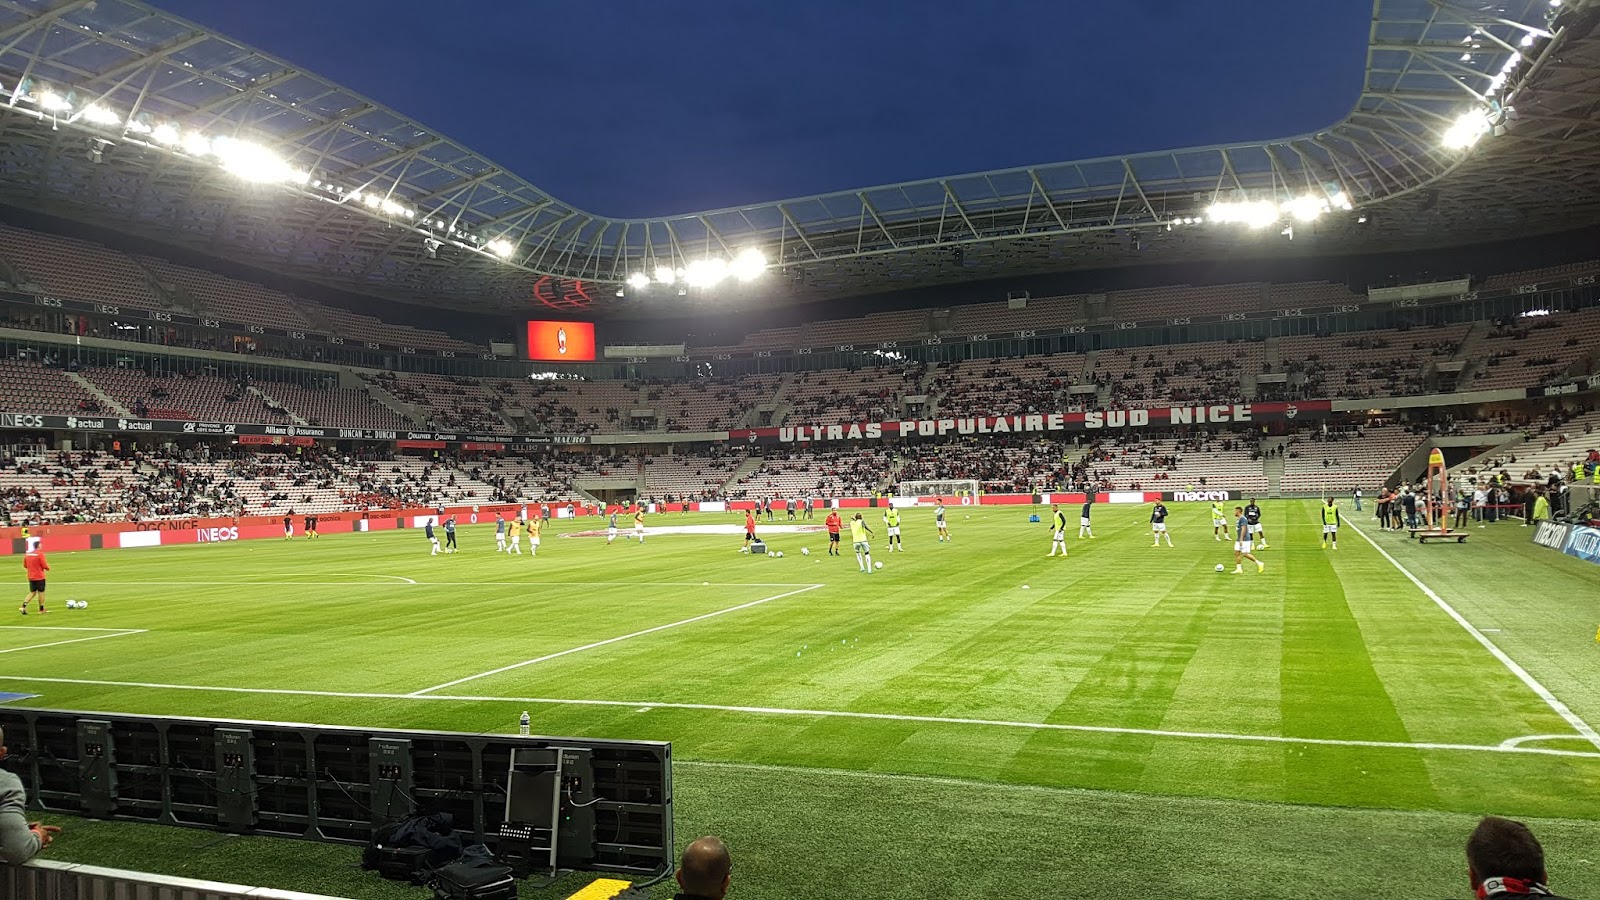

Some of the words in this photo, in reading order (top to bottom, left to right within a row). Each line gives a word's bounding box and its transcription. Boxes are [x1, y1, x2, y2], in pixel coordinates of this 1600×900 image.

[1569, 275, 1596, 286] INEOS
[1511, 284, 1538, 294] INEOS
[1451, 292, 1478, 301] INEOS
[35, 296, 62, 307] INEOS
[1392, 299, 1419, 308] INEOS
[94, 304, 119, 315] INEOS
[1277, 308, 1302, 317] INEOS
[1334, 304, 1359, 313] INEOS
[150, 311, 172, 322] INEOS
[1166, 317, 1191, 325] INEOS
[1221, 313, 1246, 321] INEOS
[199, 318, 220, 328] INEOS
[1114, 322, 1137, 330] INEOS
[245, 325, 264, 334] INEOS
[1014, 330, 1036, 338] INEOS
[1063, 326, 1086, 334] INEOS
[287, 330, 306, 340] INEOS
[967, 334, 988, 342] INEOS
[327, 336, 344, 345] INEOS
[364, 341, 380, 349] INEOS
[877, 341, 897, 349] INEOS
[921, 337, 942, 345] INEOS
[399, 347, 416, 355] INEOS
[437, 350, 455, 358] INEOS
[753, 350, 772, 358] INEOS
[794, 347, 812, 355] INEOS
[477, 352, 497, 361] INEOS
[628, 356, 647, 364] INEOS
[1, 413, 43, 427] INEOS
[78, 420, 104, 428] actual
[779, 422, 882, 442] ULTRAS
[900, 413, 1064, 437] POPULAIRE
[1085, 409, 1149, 429] SUD
[1170, 404, 1252, 424] NICE
[128, 421, 153, 430] actual
[265, 426, 287, 435] Allianz
[296, 428, 324, 436] Assurance
[340, 429, 362, 438] DUNCAN
[375, 430, 397, 439] DUNCAN
[1173, 491, 1229, 501] macron
[197, 526, 239, 542] INEOS
